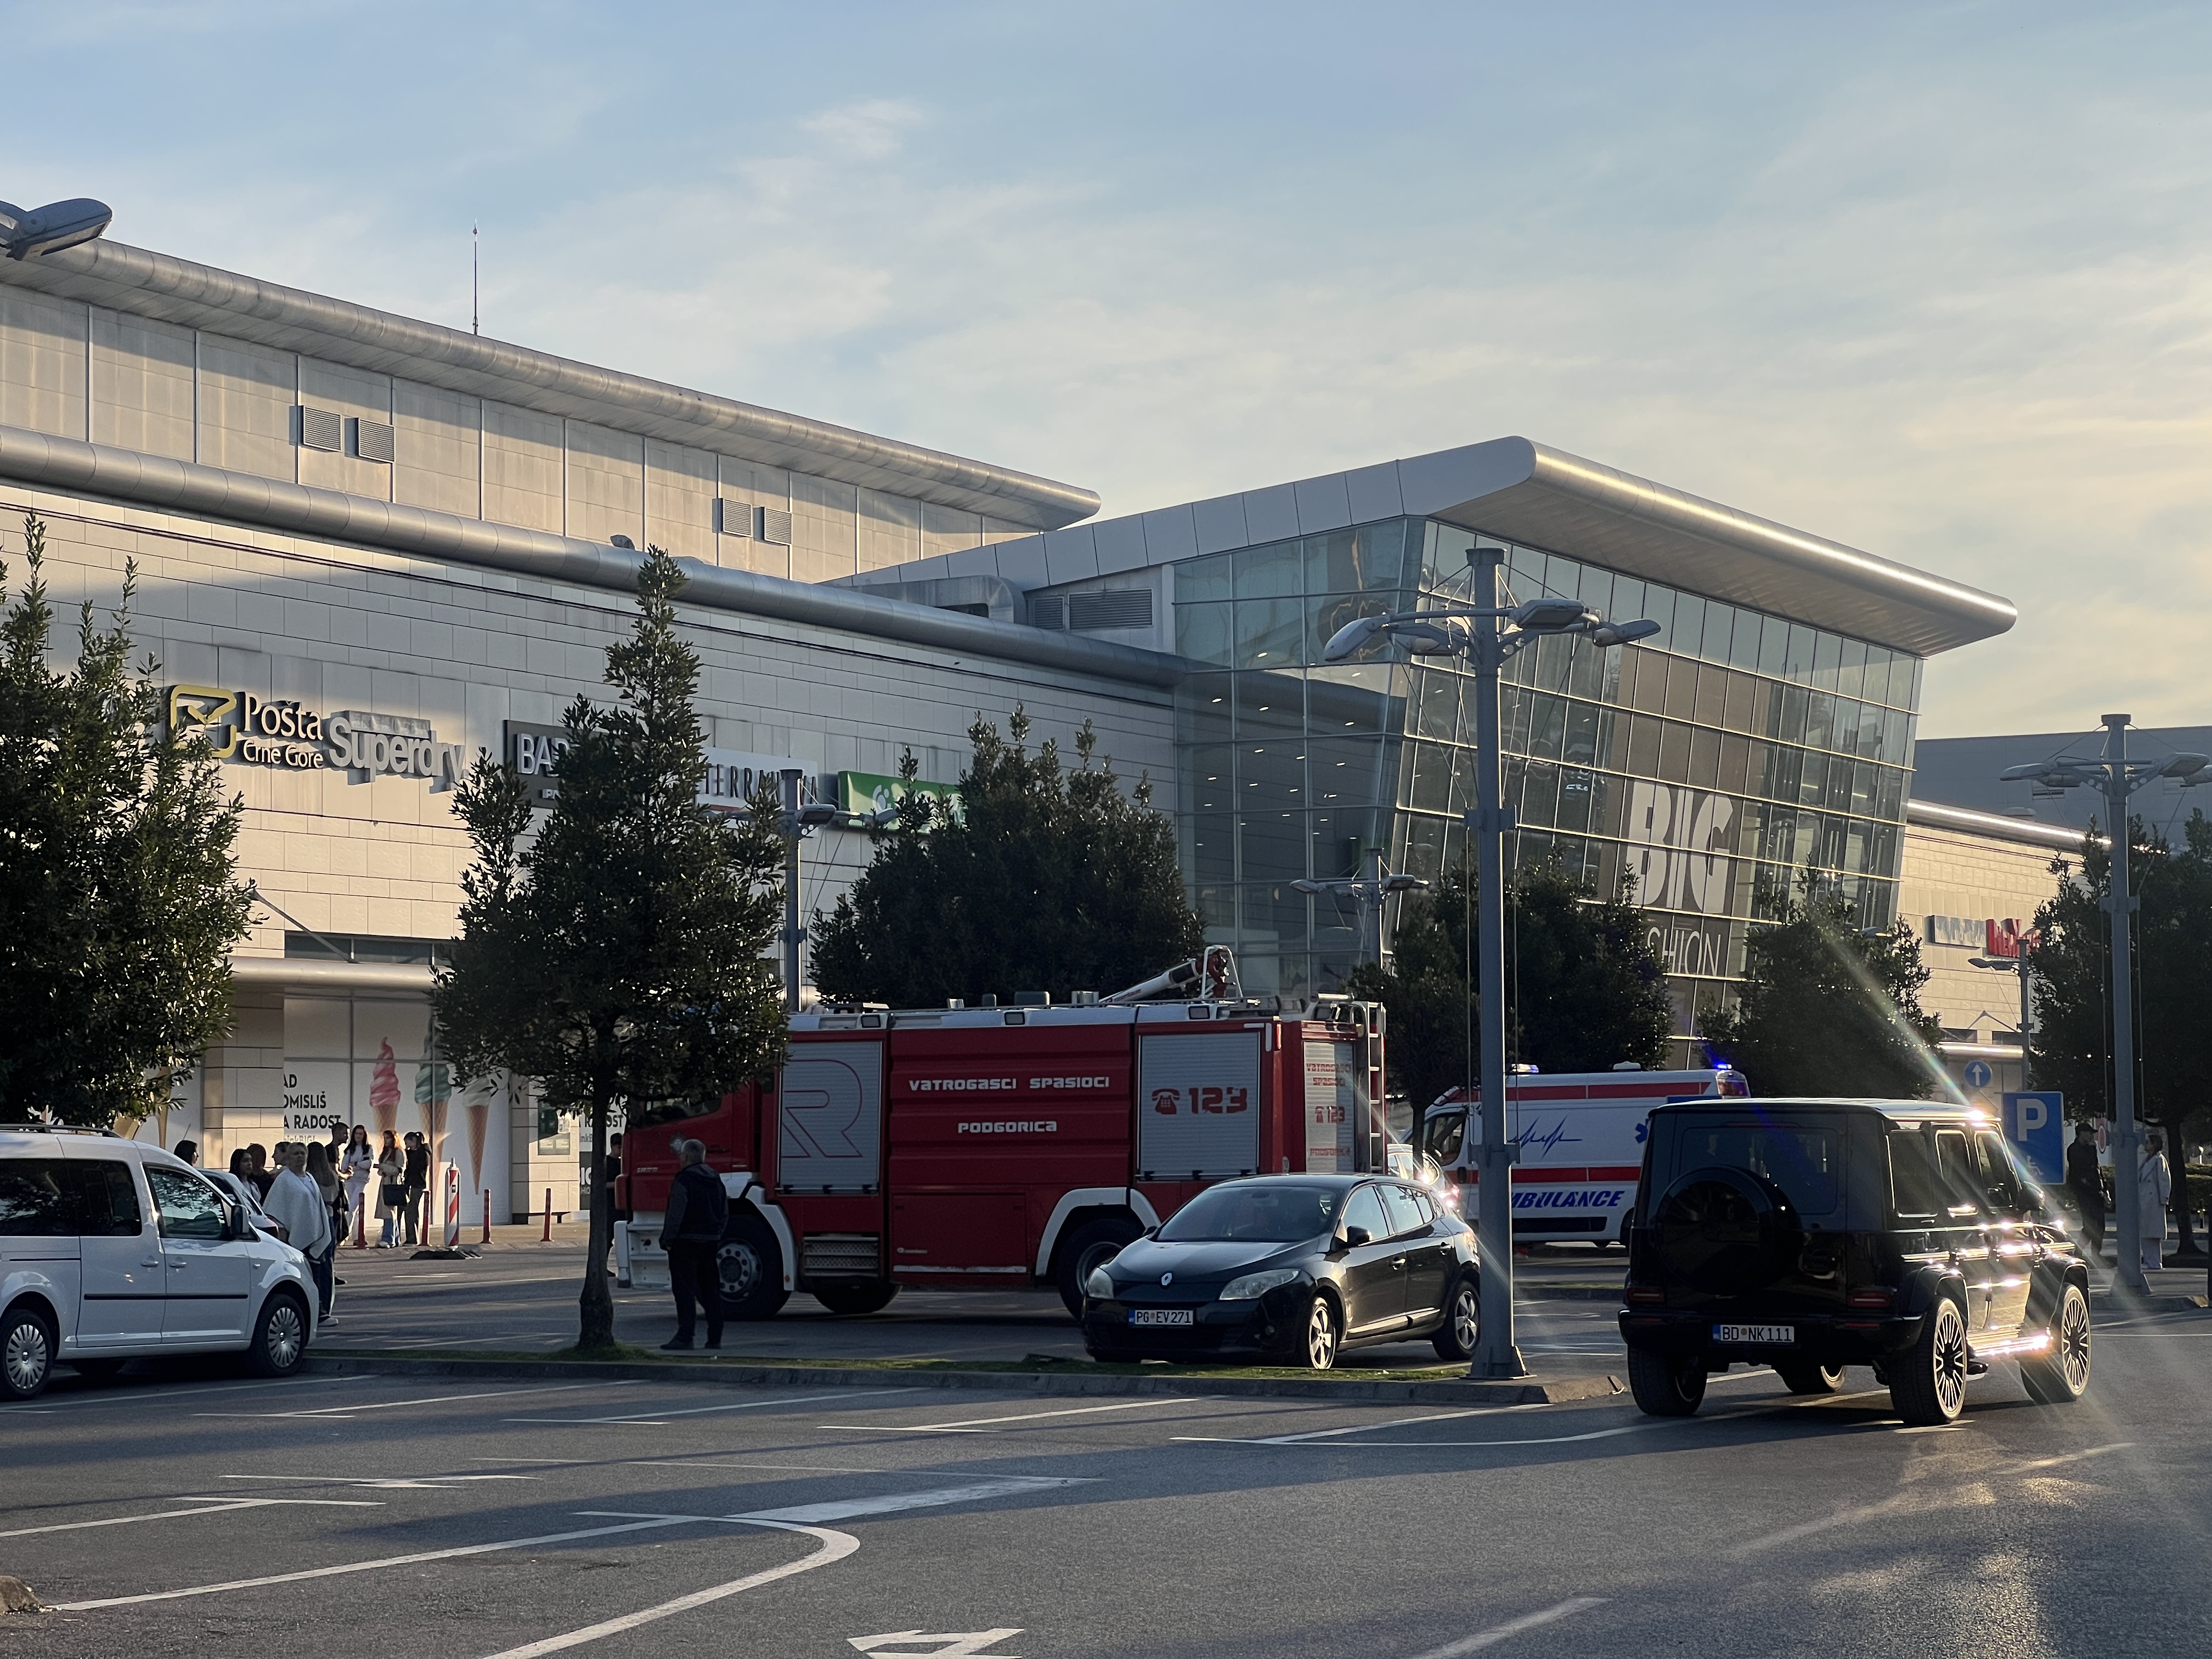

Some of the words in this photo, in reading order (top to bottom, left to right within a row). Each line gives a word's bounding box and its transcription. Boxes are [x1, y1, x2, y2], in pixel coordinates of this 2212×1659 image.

[244, 692, 323, 741] Pošta
[243, 739, 281, 764] Crne
[285, 744, 324, 768] Gore
[1624, 781, 1734, 913] BIG
[1189, 1087, 1248, 1114] 123
[1328, 1106, 1345, 1124] 123
[2017, 1099, 2047, 1141] P
